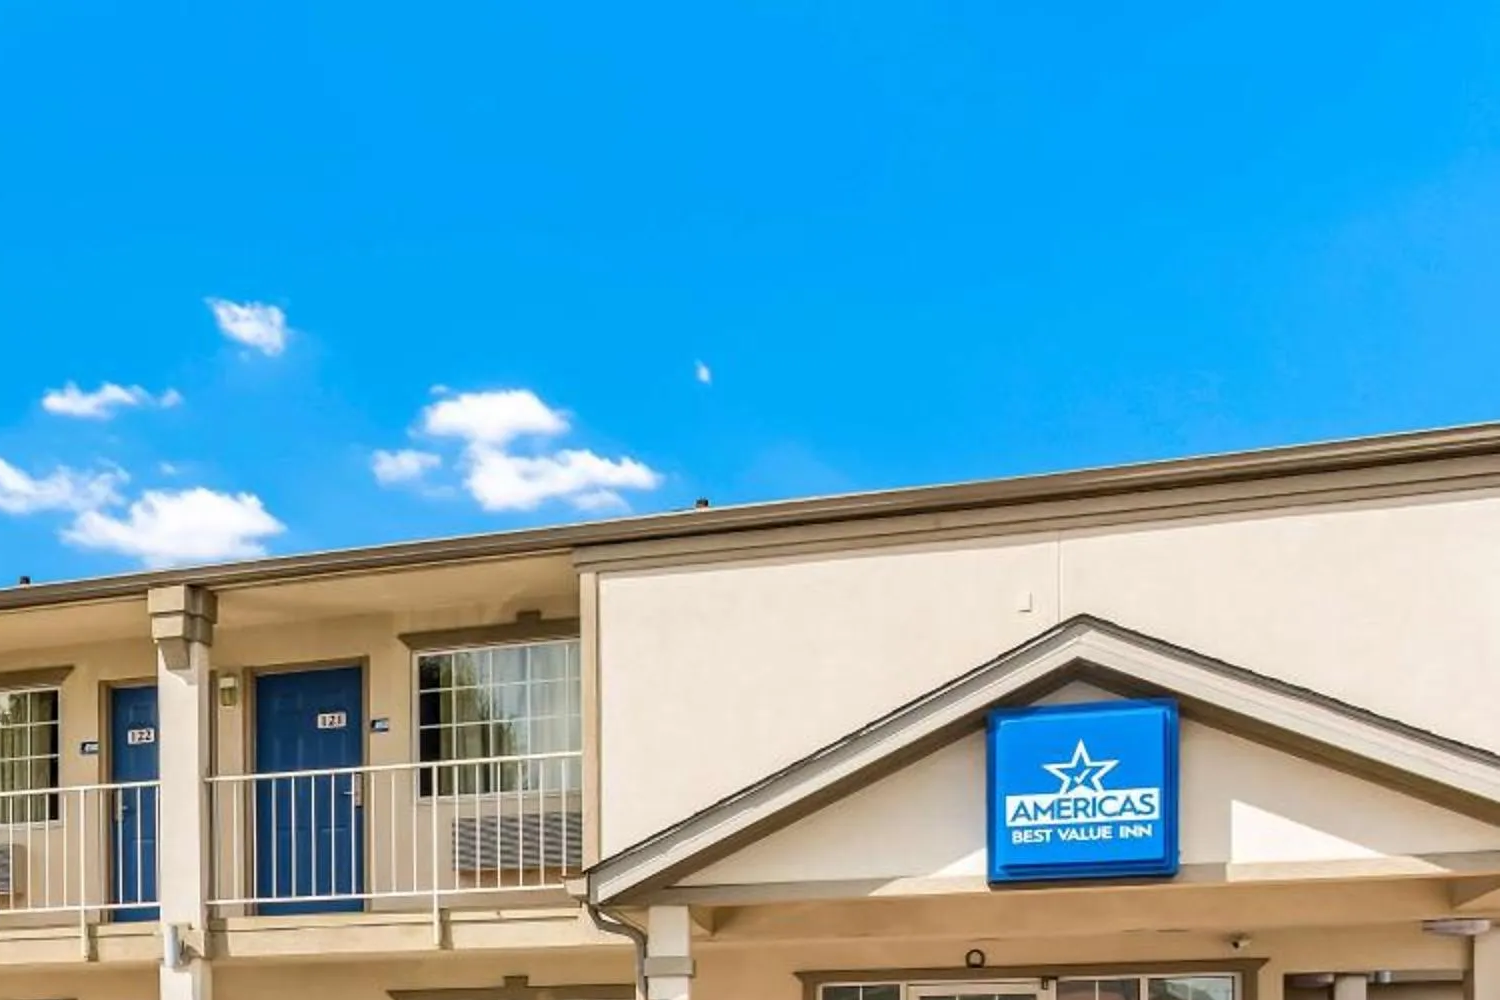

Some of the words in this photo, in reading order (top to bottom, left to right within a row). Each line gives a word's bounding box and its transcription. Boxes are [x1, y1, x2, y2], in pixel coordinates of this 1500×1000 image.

[1010, 793, 1156, 822] AMERICAS
[1011, 829, 1053, 844] BEST
[1057, 825, 1113, 842] VALUE
[1119, 823, 1152, 838] INN
